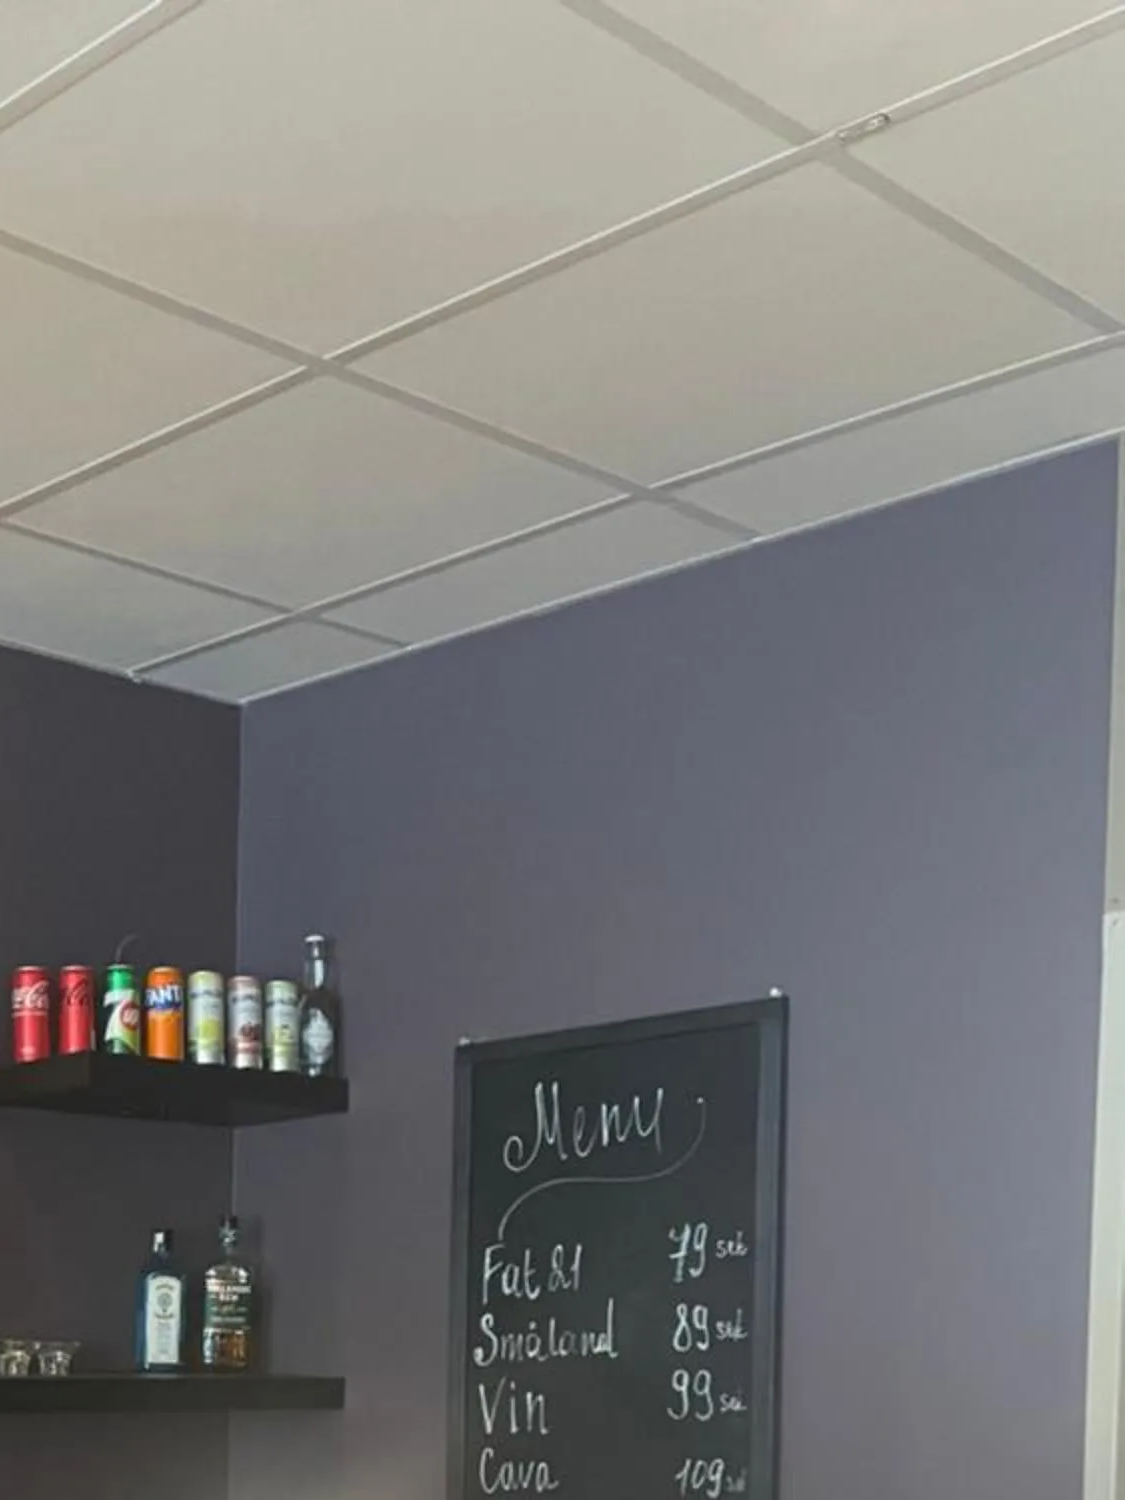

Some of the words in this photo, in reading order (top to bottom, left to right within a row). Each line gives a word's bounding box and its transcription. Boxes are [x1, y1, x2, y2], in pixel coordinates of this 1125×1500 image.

[482, 1243, 542, 1306] Fat
[668, 1221, 709, 1284] 79
[671, 1302, 711, 1352] 89
[477, 1375, 550, 1436] Vin
[666, 1368, 714, 1422] 99
[478, 1446, 560, 1495] Cava
[674, 1456, 725, 1500] 109
